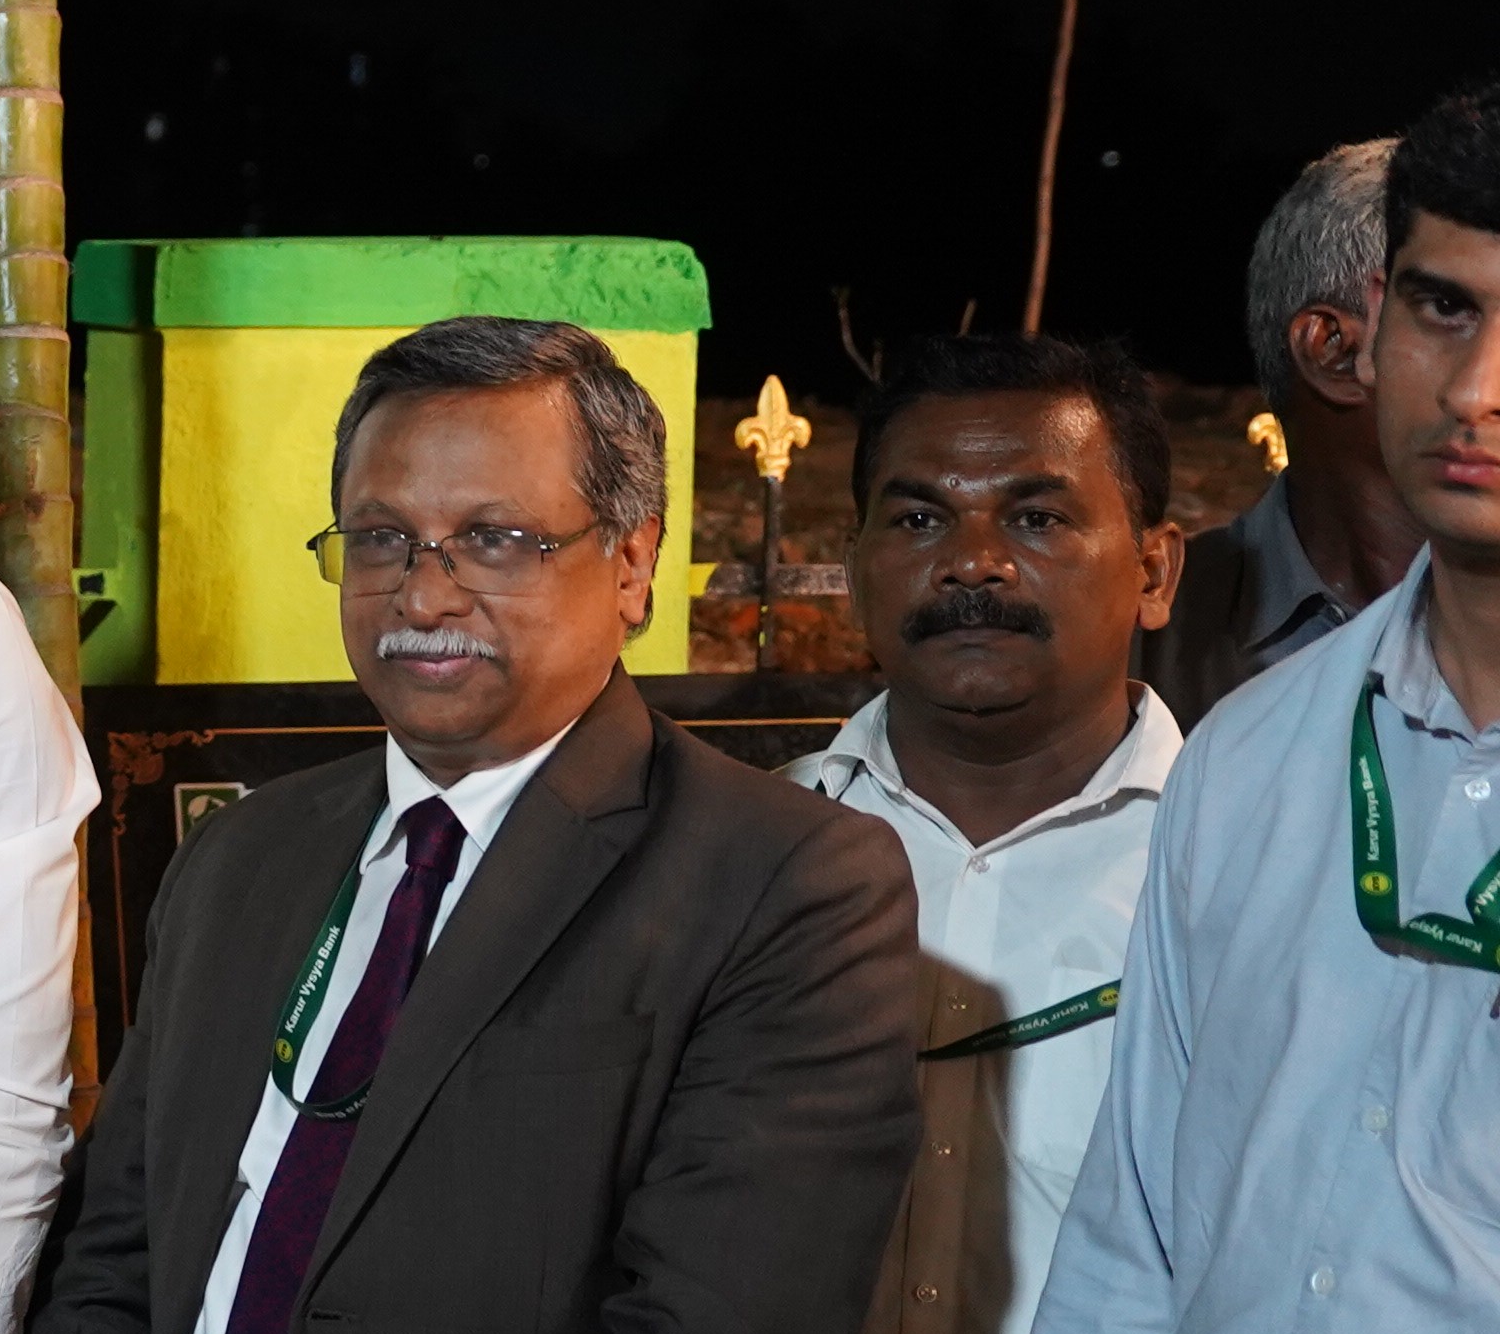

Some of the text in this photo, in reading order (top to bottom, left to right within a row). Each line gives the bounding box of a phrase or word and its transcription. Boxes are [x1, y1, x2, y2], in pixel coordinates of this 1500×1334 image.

[285, 924, 342, 1034] Karur Vysya Bank
